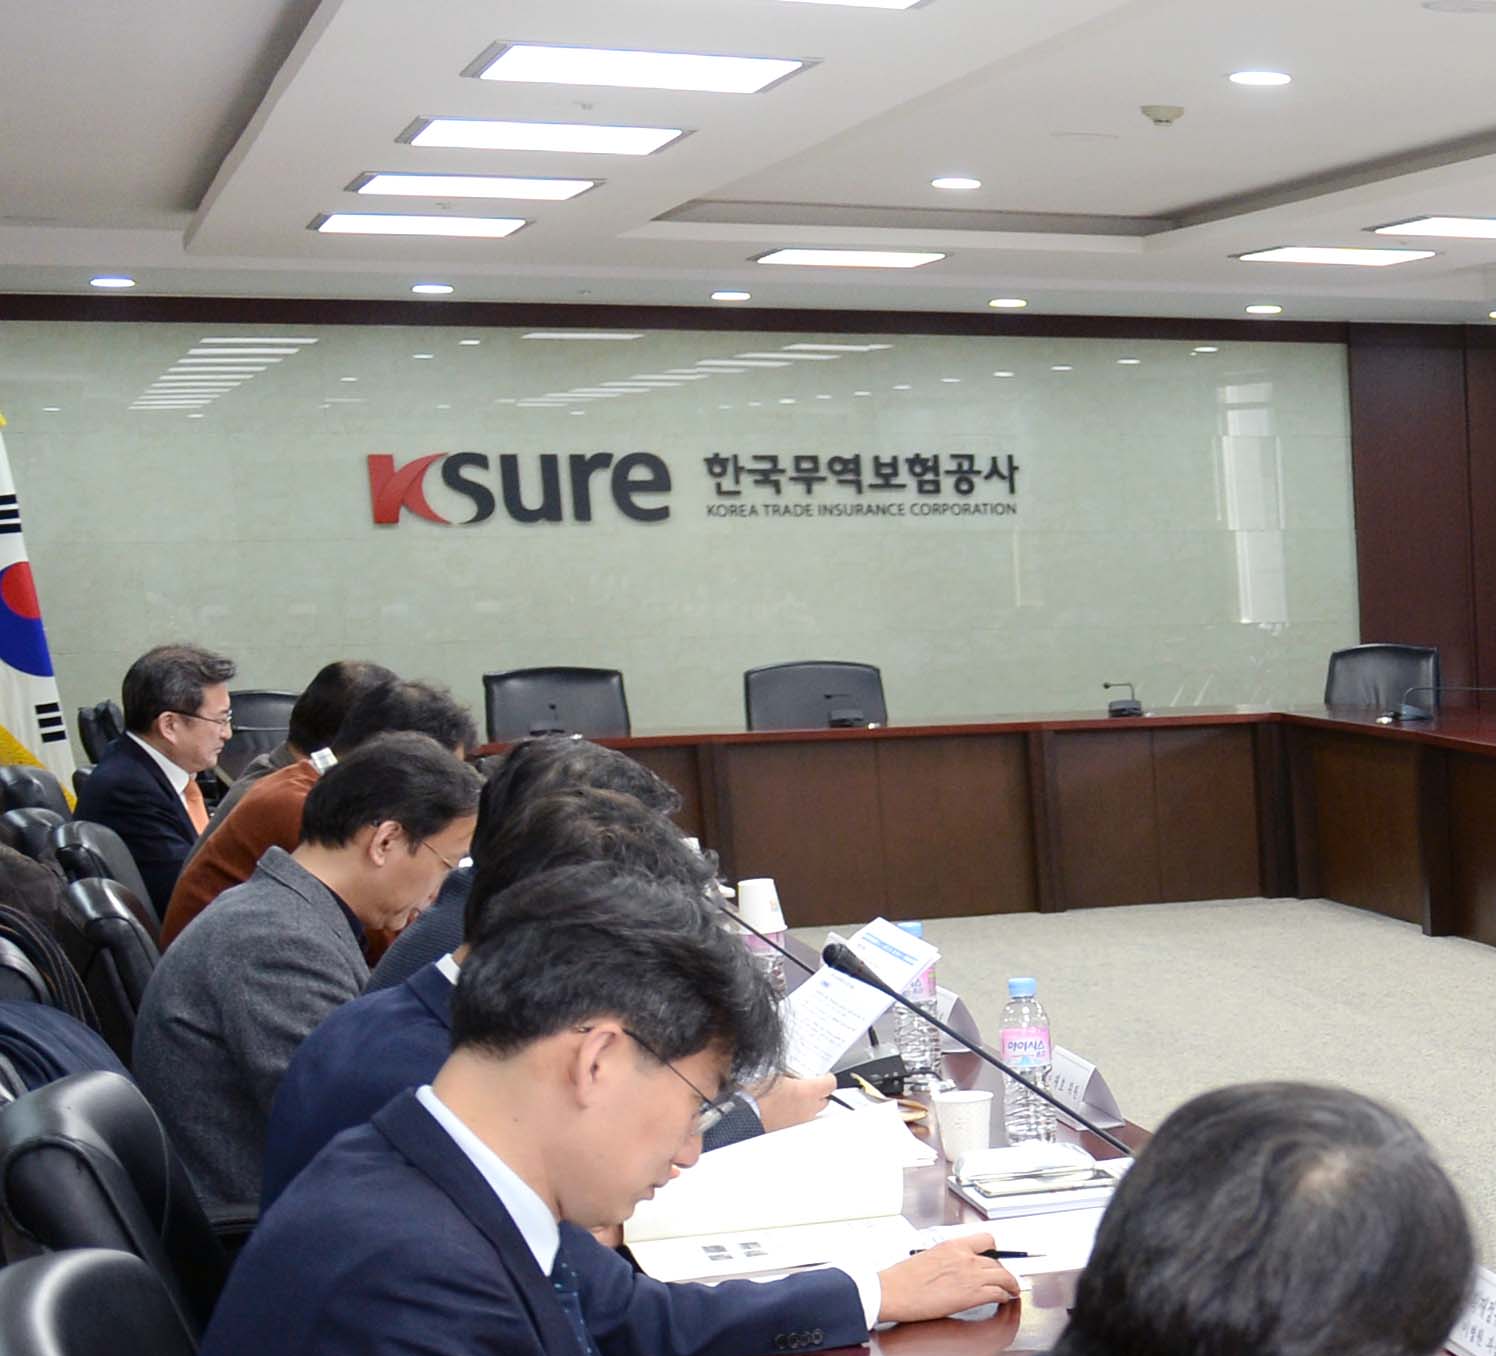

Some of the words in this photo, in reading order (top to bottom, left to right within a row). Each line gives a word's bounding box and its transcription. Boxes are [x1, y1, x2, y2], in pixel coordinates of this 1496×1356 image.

[704, 454, 1019, 497] 한국무역보험공사
[706, 502, 759, 518] KOREA
[763, 502, 814, 518] TRADE
[818, 502, 906, 517] INSURANCE
[909, 502, 1018, 517] CORPORATION
